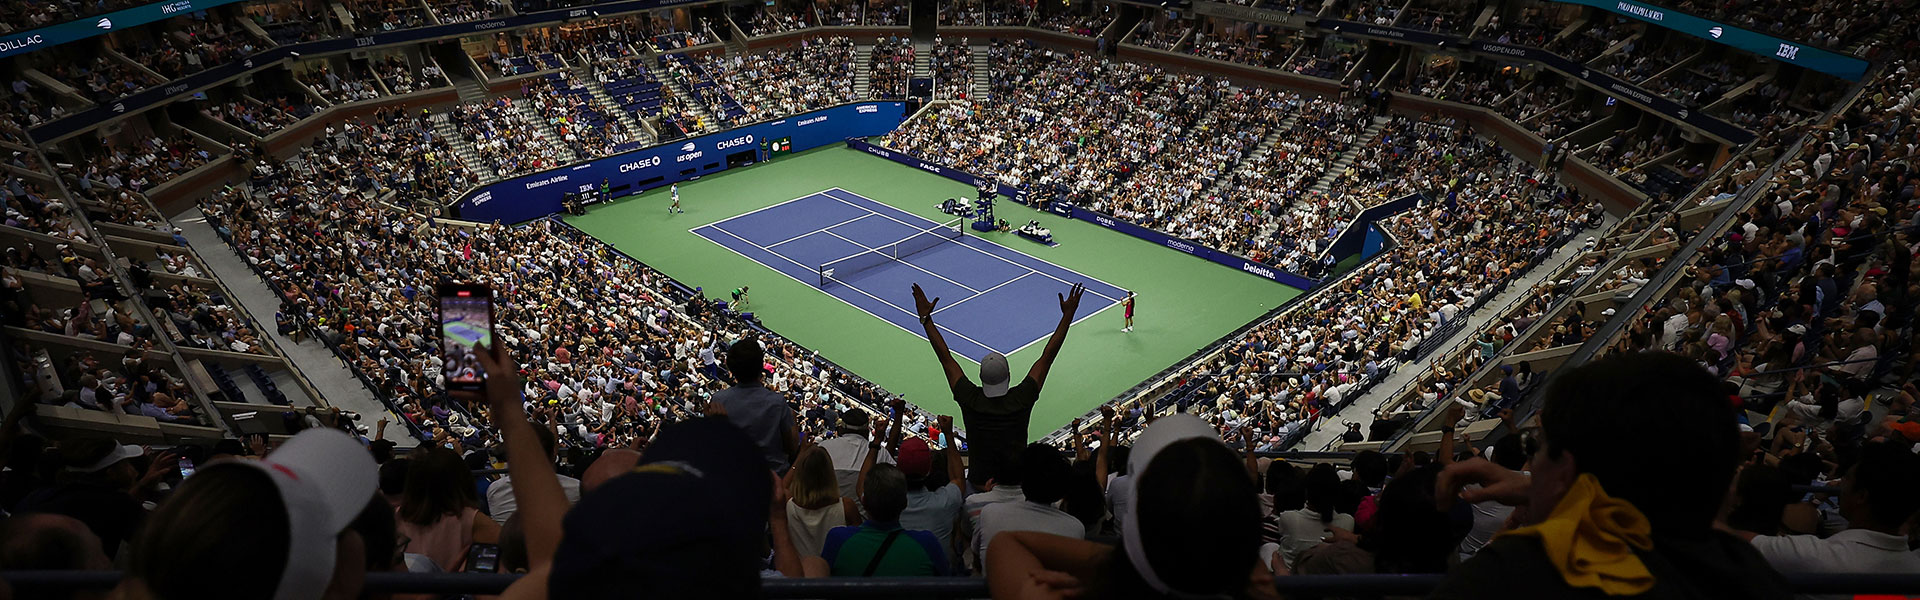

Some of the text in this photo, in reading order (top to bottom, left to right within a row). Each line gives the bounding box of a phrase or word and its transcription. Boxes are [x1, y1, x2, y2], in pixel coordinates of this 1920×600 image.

[161, 3, 177, 14] IHG
[474, 20, 506, 30] moderna
[355, 36, 376, 47] IBM
[1482, 44, 1526, 56] USOPEN.ORG
[1776, 43, 1800, 60] IBM
[717, 137, 746, 150] CHASE
[685, 150, 702, 162] open
[868, 146, 890, 158] CHUBB
[619, 158, 652, 173] CHASE
[579, 183, 594, 193] IBM
[1096, 216, 1115, 227] DOBEL
[1167, 239, 1195, 252] moderna
[1243, 262, 1276, 280] Deloitte.
